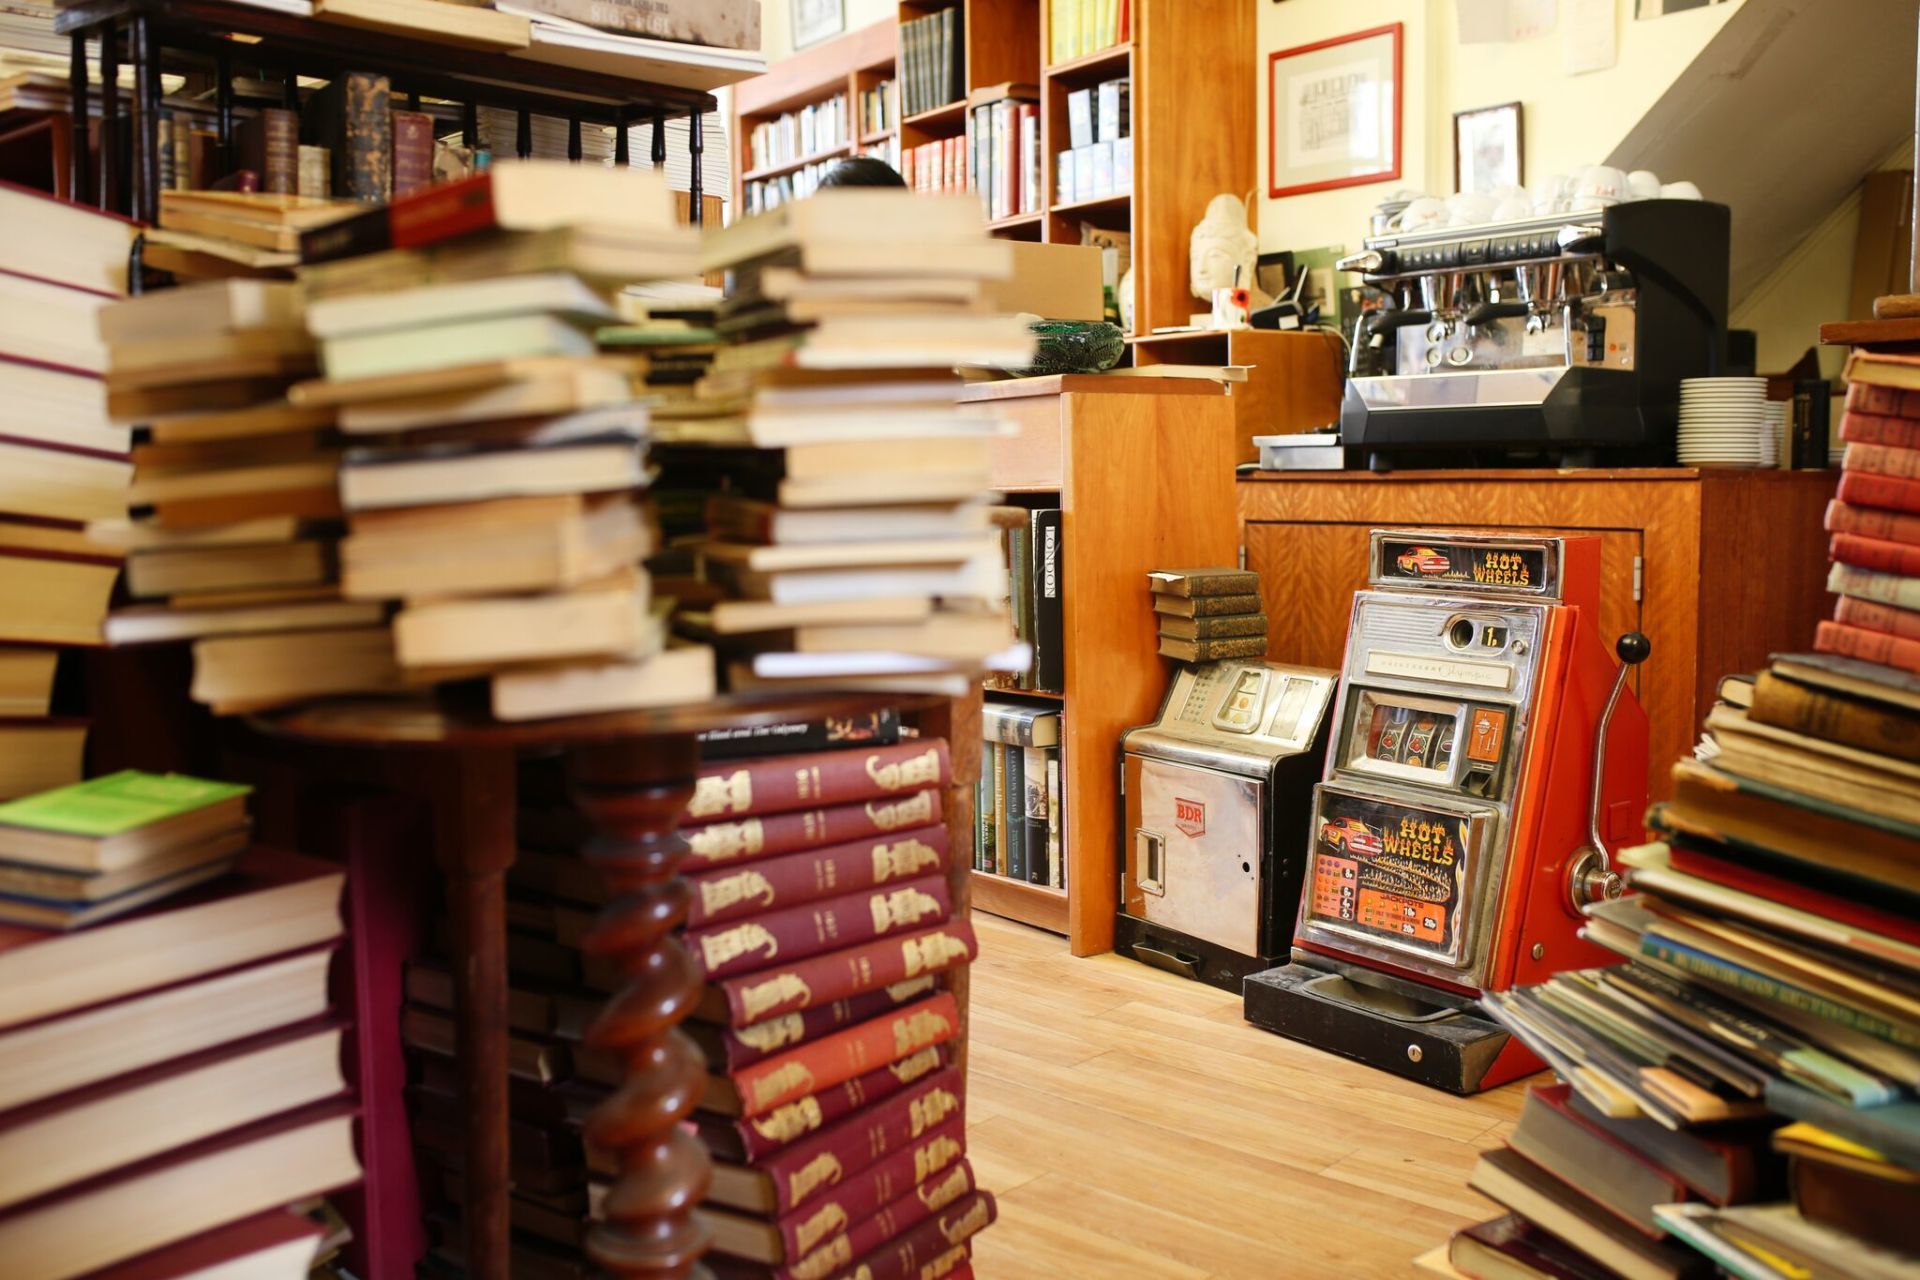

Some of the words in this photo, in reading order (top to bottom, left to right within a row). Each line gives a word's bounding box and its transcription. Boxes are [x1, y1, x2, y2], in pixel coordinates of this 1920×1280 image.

[1045, 529, 1055, 597] LONDON
[1486, 552, 1521, 570] HOT
[1473, 562, 1529, 586] WHEELS
[1177, 804, 1202, 823] BDR
[1400, 817, 1446, 844] HOT
[1383, 828, 1454, 865] WHEELS
[1380, 894, 1424, 908] JACKPOTS
